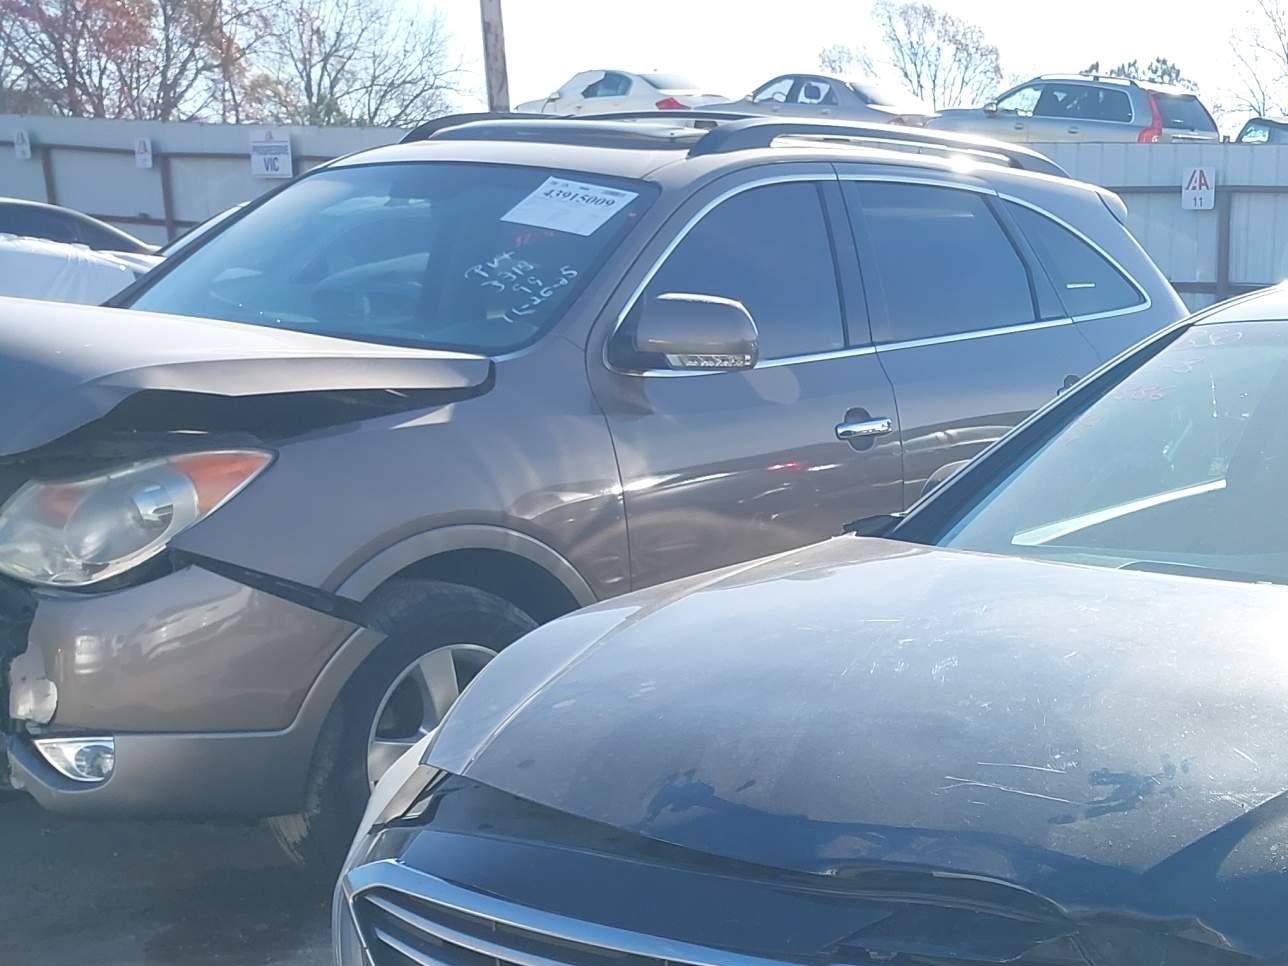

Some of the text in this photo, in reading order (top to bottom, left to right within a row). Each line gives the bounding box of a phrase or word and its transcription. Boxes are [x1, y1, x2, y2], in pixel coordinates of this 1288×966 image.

[263, 157, 280, 172] VIC
[543, 189, 616, 207] 43915009
[1193, 196, 1203, 209] 11
